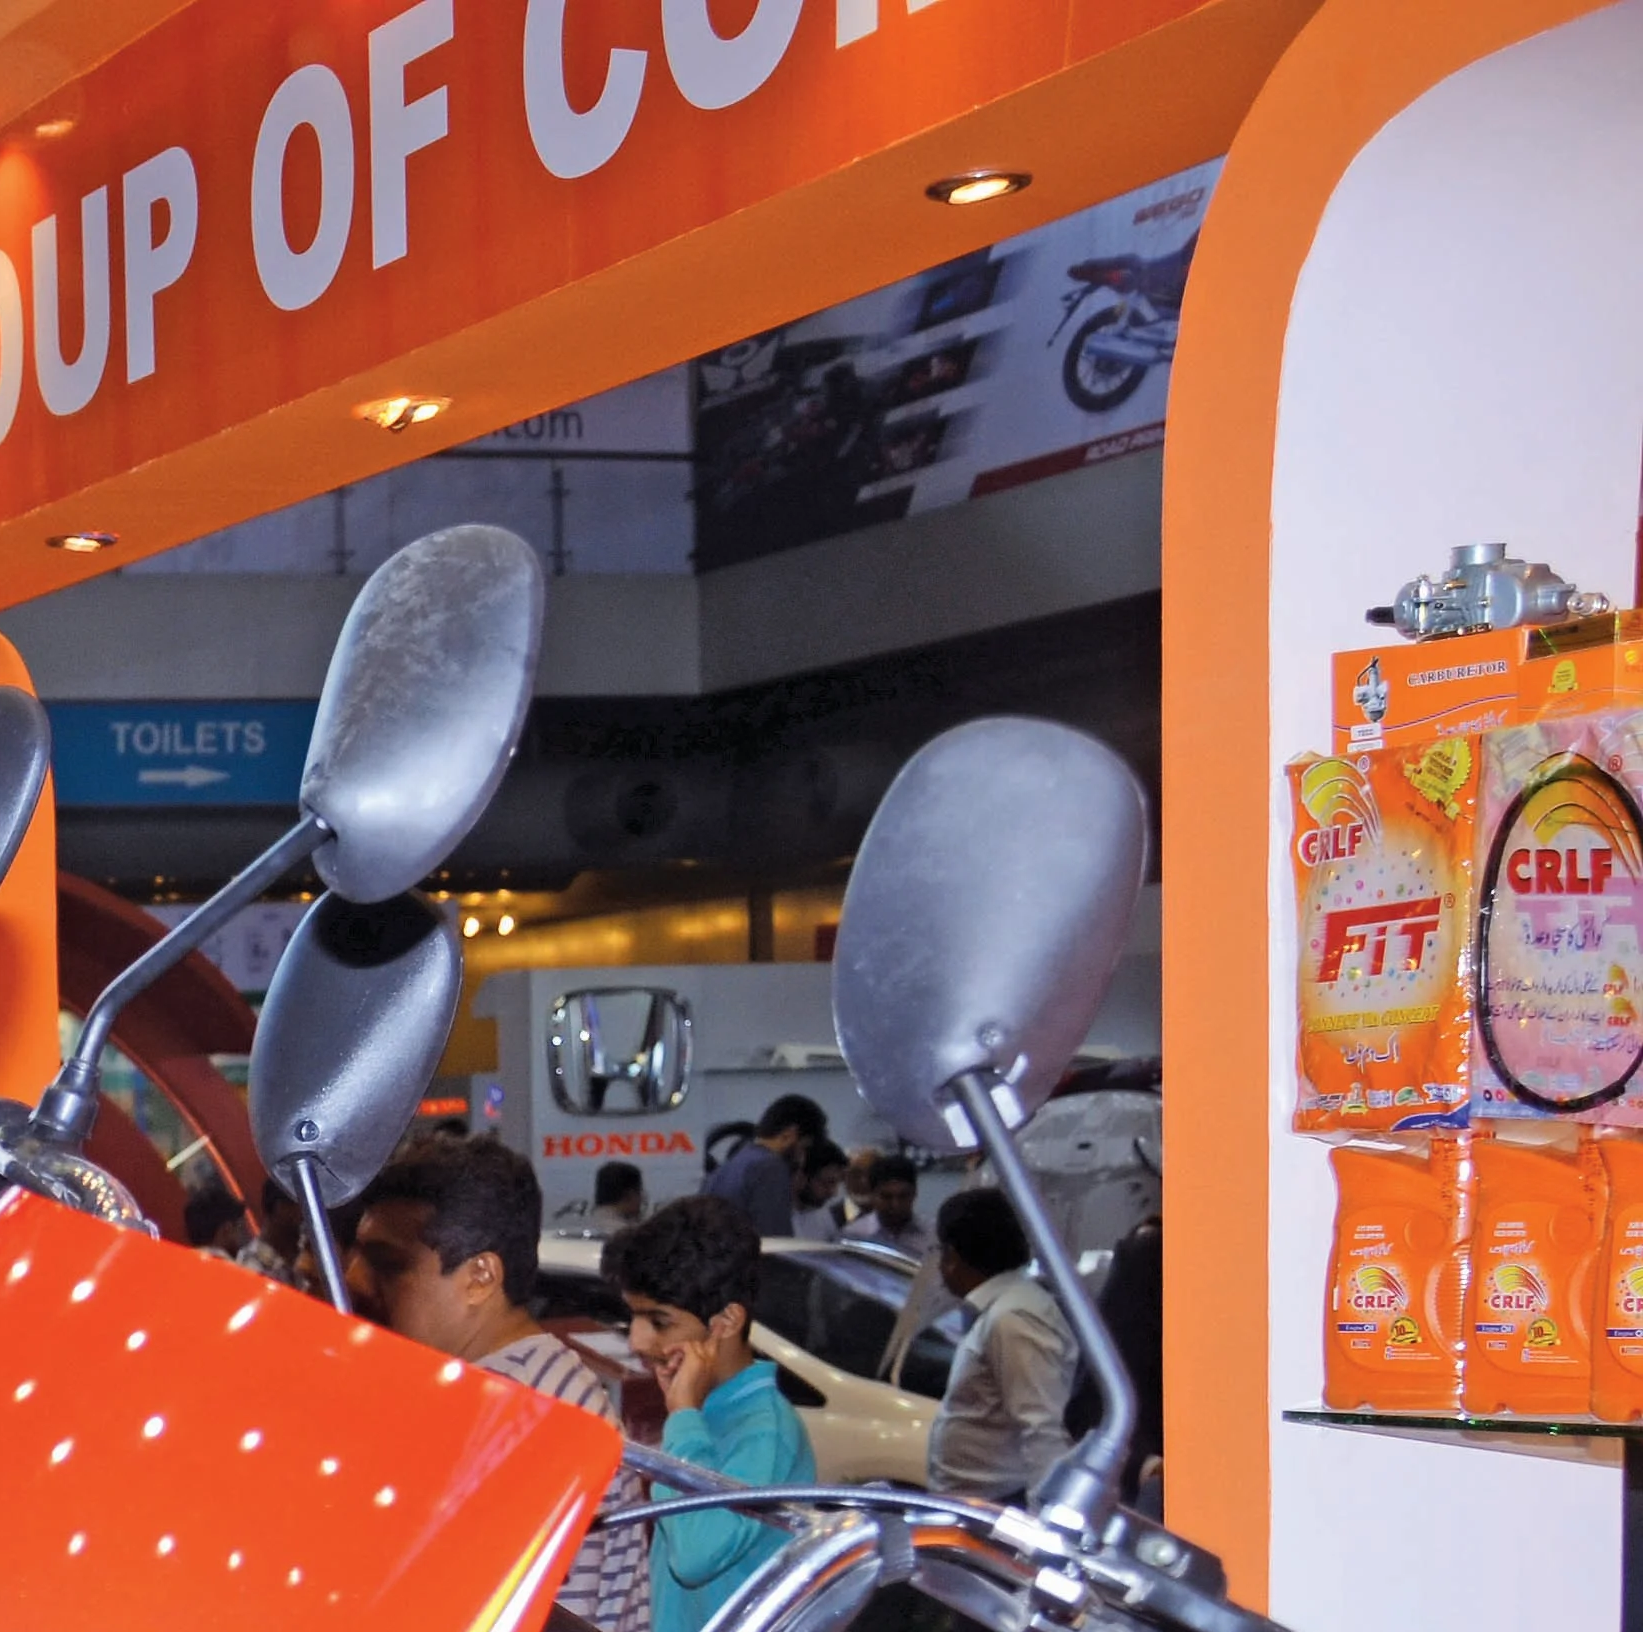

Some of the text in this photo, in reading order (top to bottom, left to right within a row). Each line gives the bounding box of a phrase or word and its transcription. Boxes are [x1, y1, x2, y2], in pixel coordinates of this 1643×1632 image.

[251, 0, 455, 312] OF
[1407, 660, 1507, 687] CARBURETOR
[111, 720, 266, 756] TOILETS
[1299, 823, 1364, 866] CRLF
[1506, 848, 1613, 895] CRLF
[543, 1130, 697, 1157] HONDA
[1353, 1294, 1397, 1309] CRLF
[1491, 1294, 1535, 1309] CRLF
